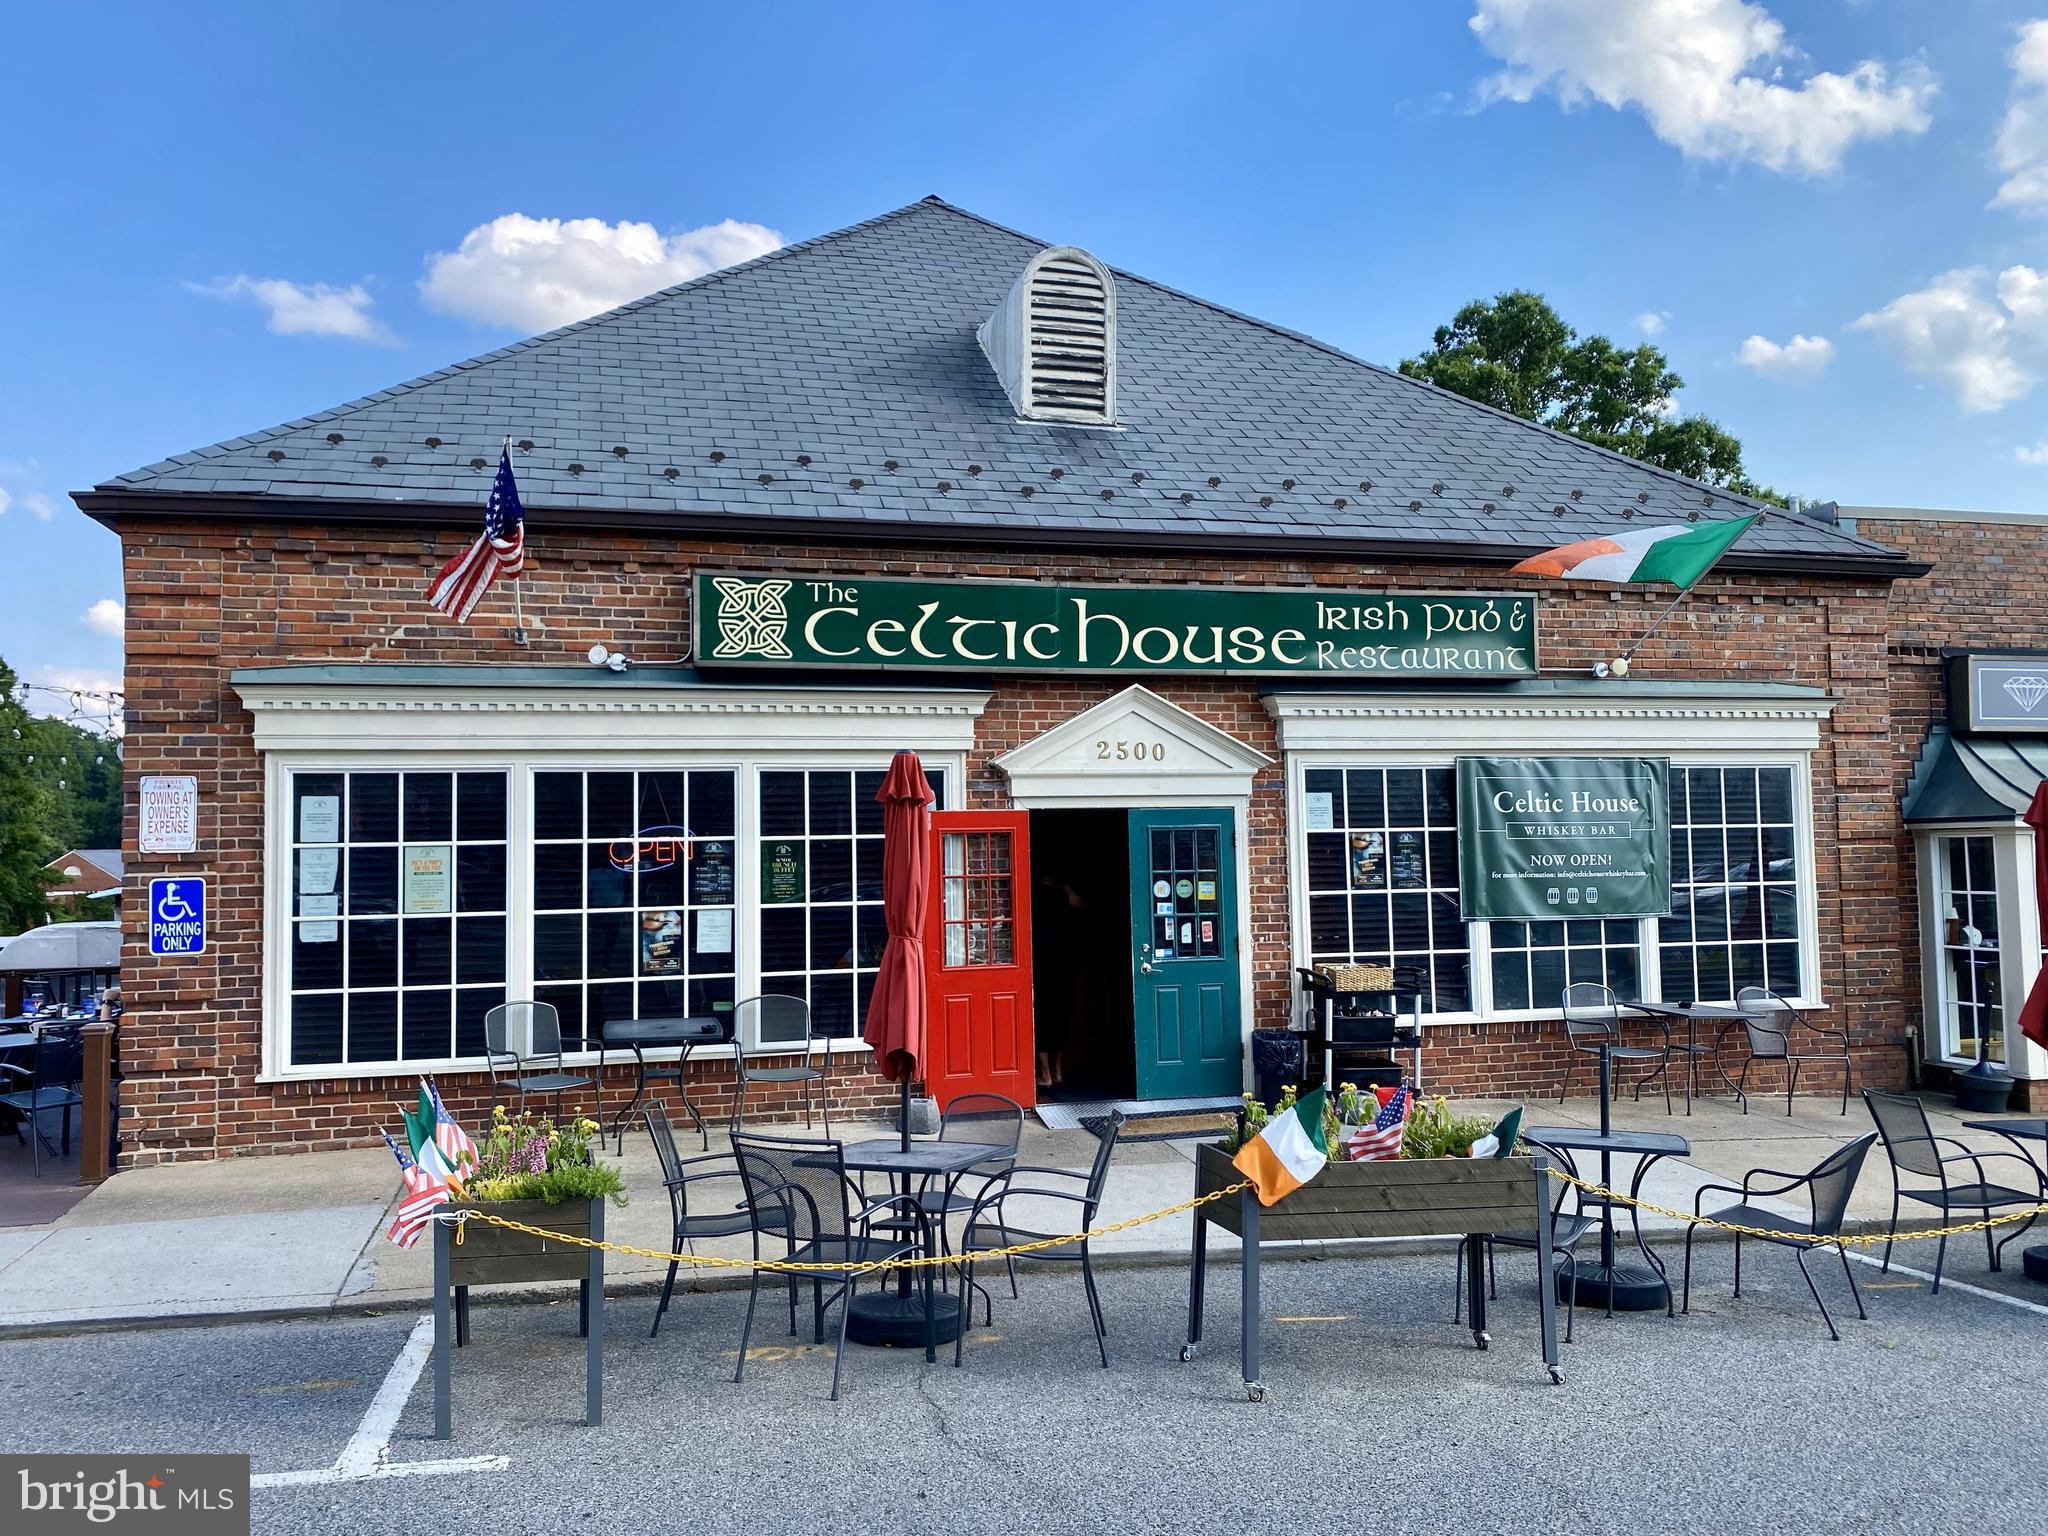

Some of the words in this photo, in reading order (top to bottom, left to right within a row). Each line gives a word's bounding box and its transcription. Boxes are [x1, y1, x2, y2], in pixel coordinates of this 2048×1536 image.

[805, 582, 858, 603] The
[1510, 601, 1527, 632] &
[804, 601, 1061, 661] Celtic
[1096, 740, 1166, 761] 2500
[144, 791, 180, 805] TOWING
[182, 791, 194, 805] AT
[1493, 789, 1564, 813] Celtic
[1570, 791, 1639, 813] House
[147, 806, 190, 820] OWNER'S
[147, 820, 189, 834] EXPENSE
[1524, 825, 1585, 836] WHISKEY
[1591, 825, 1617, 835] BAR
[609, 834, 693, 863] OPEN
[1530, 855, 1567, 867] NOW
[1570, 854, 1612, 866] OPEN!
[1491, 871, 1502, 879] for
[1518, 870, 1556, 879] information:
[154, 922, 202, 937] PARKING
[162, 936, 193, 951] ONLY
